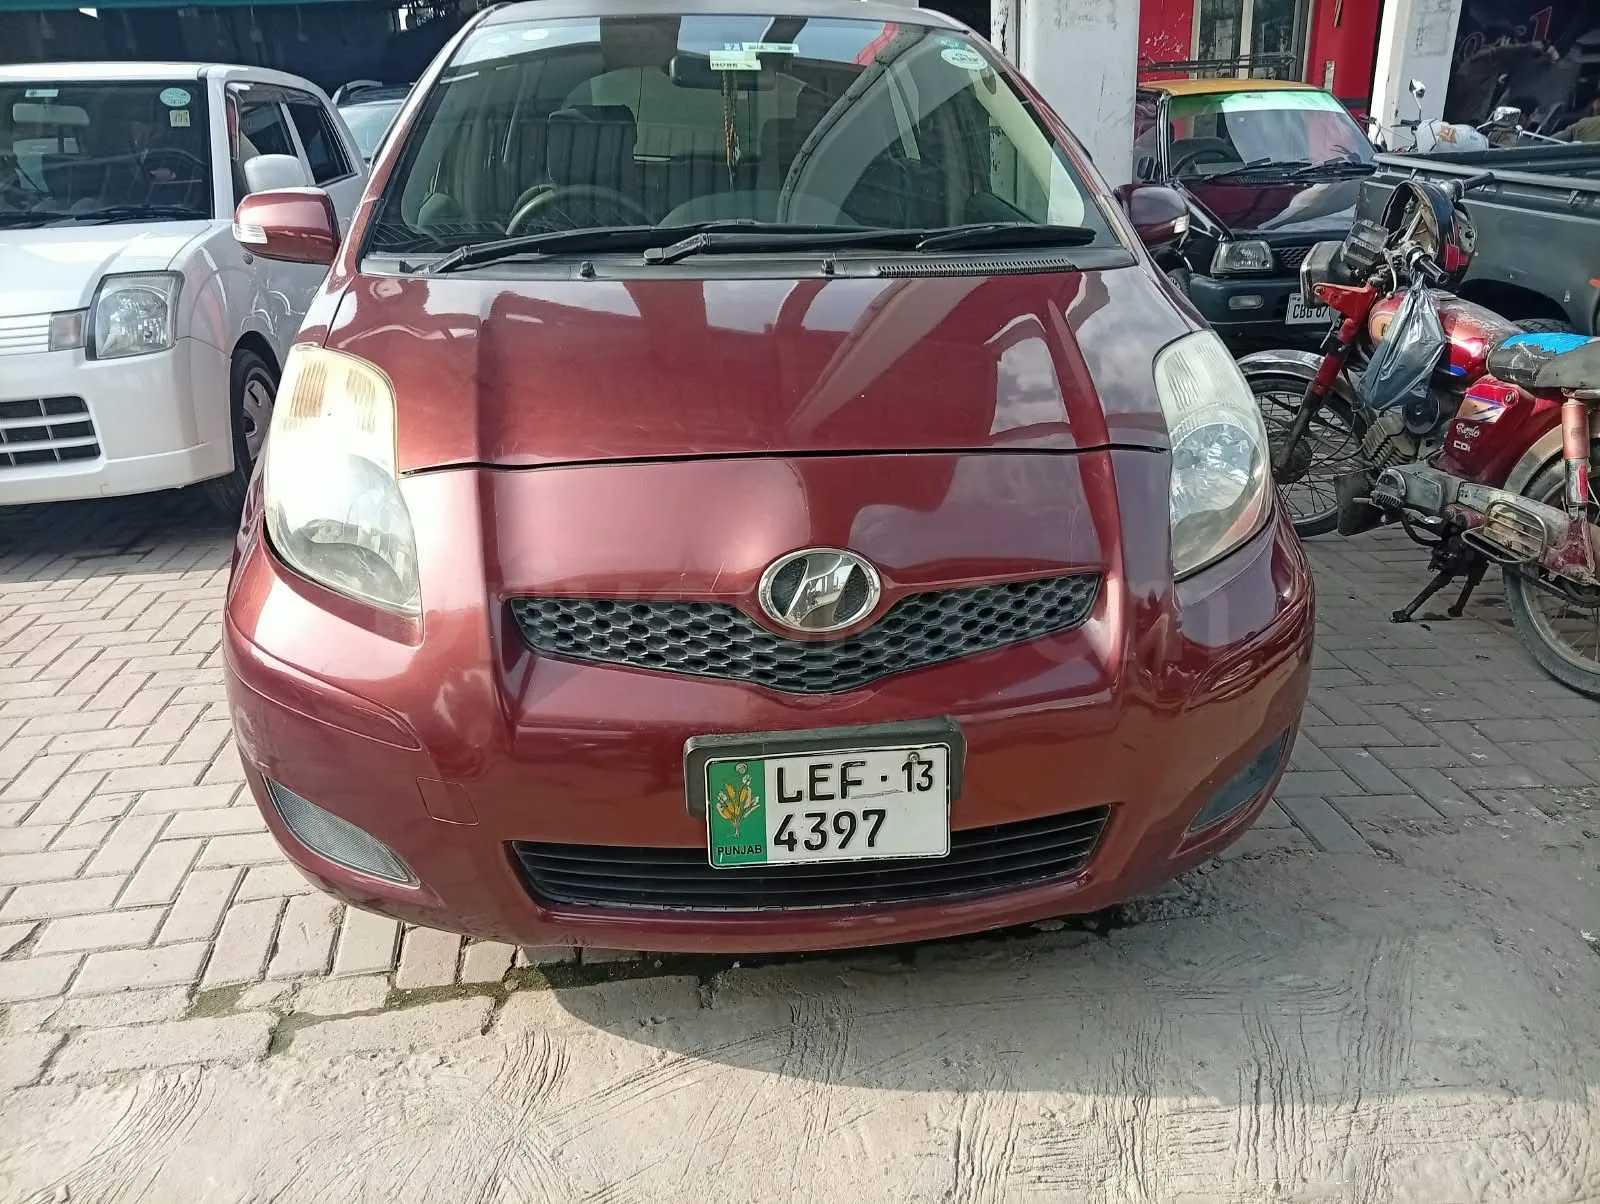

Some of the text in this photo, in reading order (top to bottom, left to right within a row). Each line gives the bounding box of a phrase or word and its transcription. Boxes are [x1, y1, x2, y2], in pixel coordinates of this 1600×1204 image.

[775, 759, 867, 805] LEF
[900, 759, 935, 793] 13
[716, 843, 764, 857] PUNJAB
[772, 807, 887, 852] 4397
